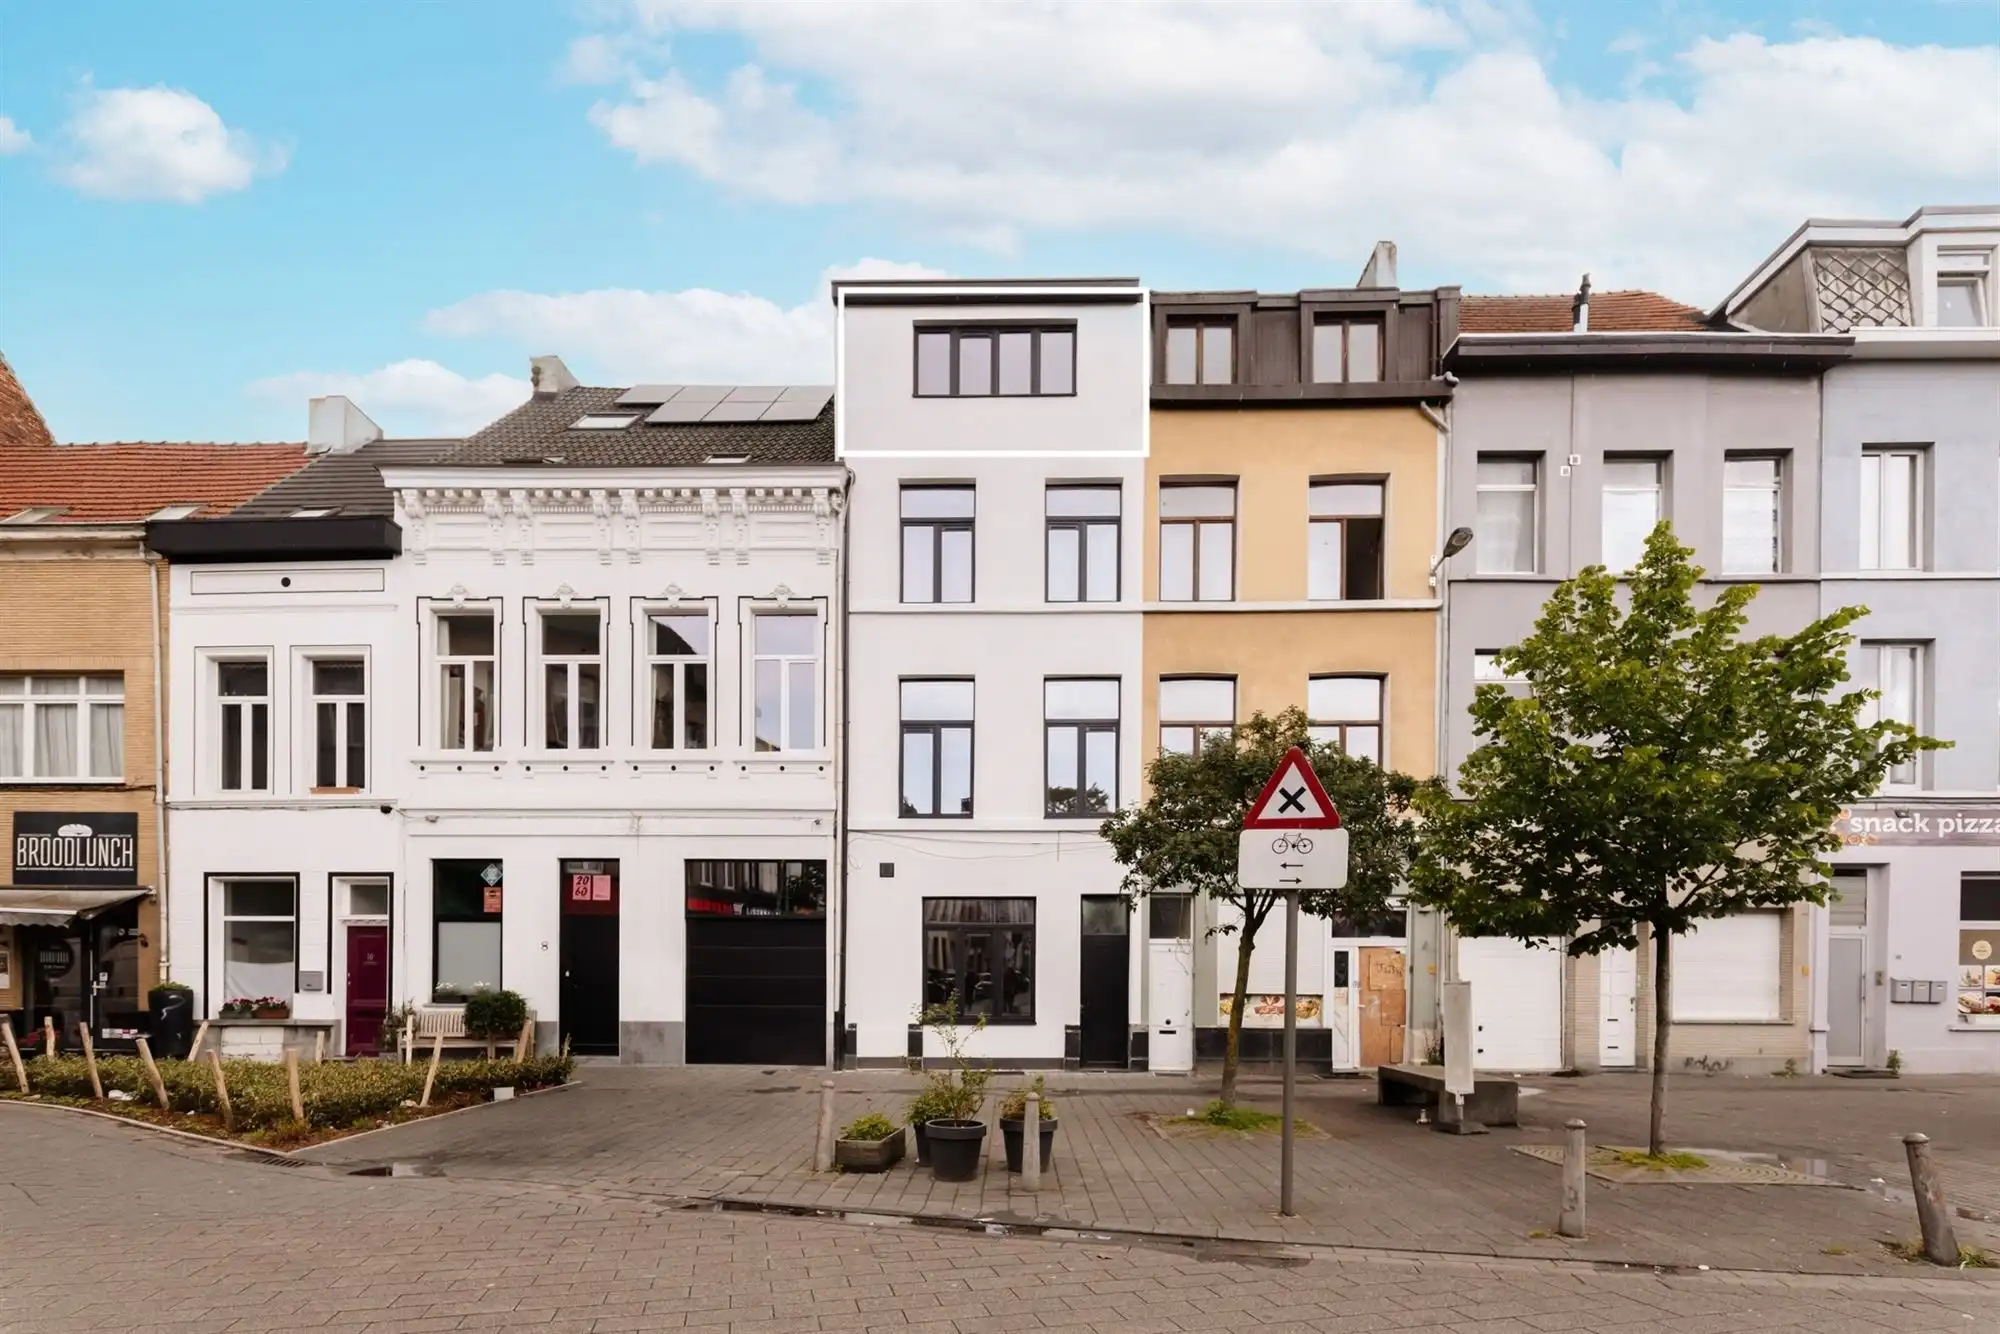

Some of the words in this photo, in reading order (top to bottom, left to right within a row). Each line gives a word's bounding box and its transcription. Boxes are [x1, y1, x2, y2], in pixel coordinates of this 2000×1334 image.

[1850, 813, 1930, 833] snack
[17, 837, 133, 867] BROODLUNCH
[576, 875, 590, 885] 20
[575, 887, 588, 896] 60
